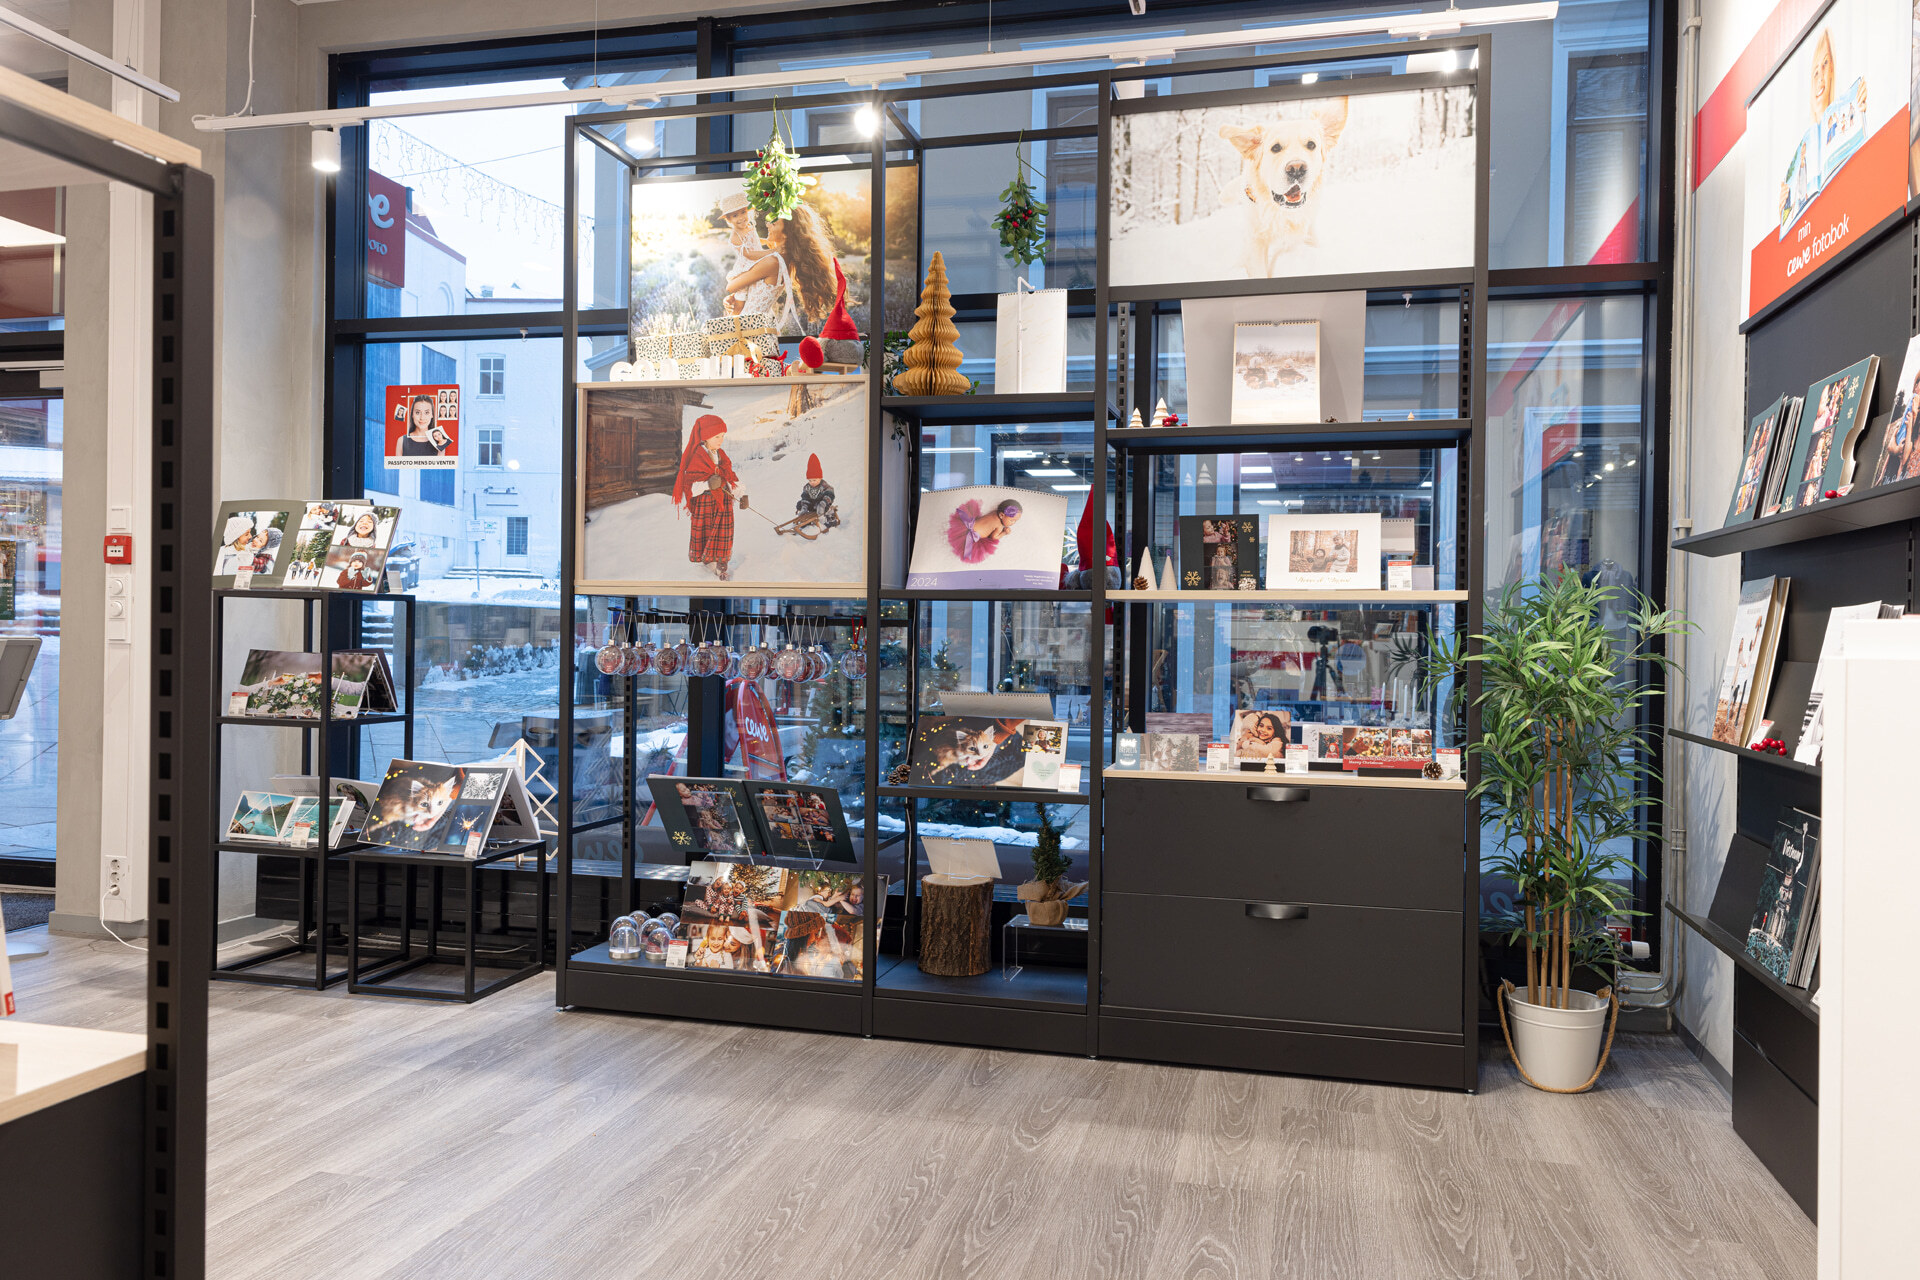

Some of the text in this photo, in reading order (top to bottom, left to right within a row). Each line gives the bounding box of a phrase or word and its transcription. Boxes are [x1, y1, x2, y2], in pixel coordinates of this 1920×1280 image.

[1798, 220, 1811, 243] min
[1787, 213, 1849, 277] cewe fotobok
[910, 577, 938, 587] 2024
[745, 716, 769, 743] cewe
[1782, 838, 1802, 862] Vietnam
